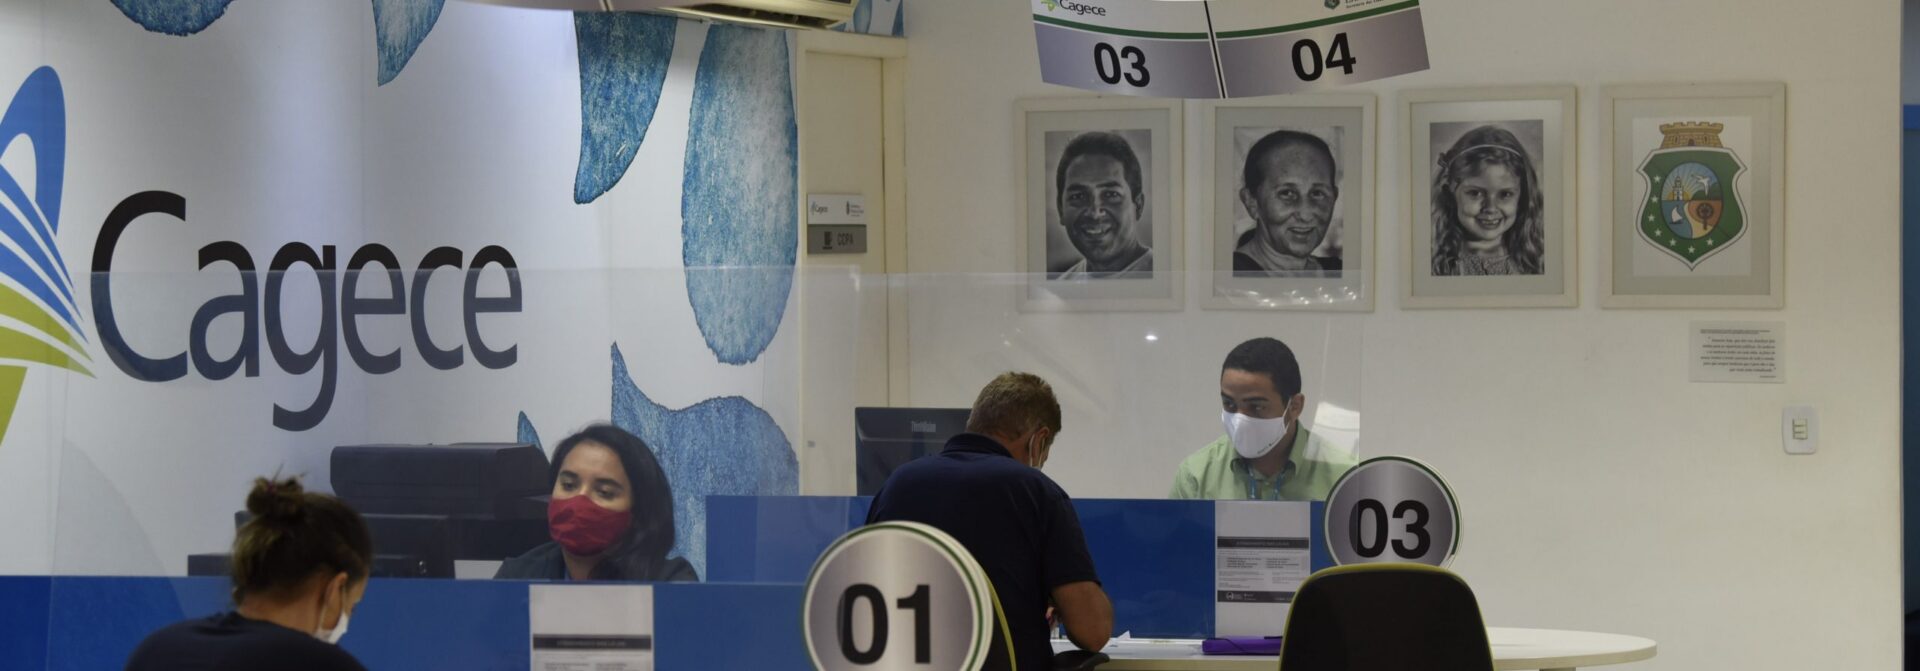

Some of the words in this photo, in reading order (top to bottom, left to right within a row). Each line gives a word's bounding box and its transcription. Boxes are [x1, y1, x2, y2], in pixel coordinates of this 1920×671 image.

[1059, 0, 1106, 16] Cagece
[1093, 42, 1150, 88] 03
[1291, 32, 1356, 81] 04
[90, 190, 522, 431] Cagece
[1349, 498, 1431, 559] 03
[836, 583, 931, 665] 01
